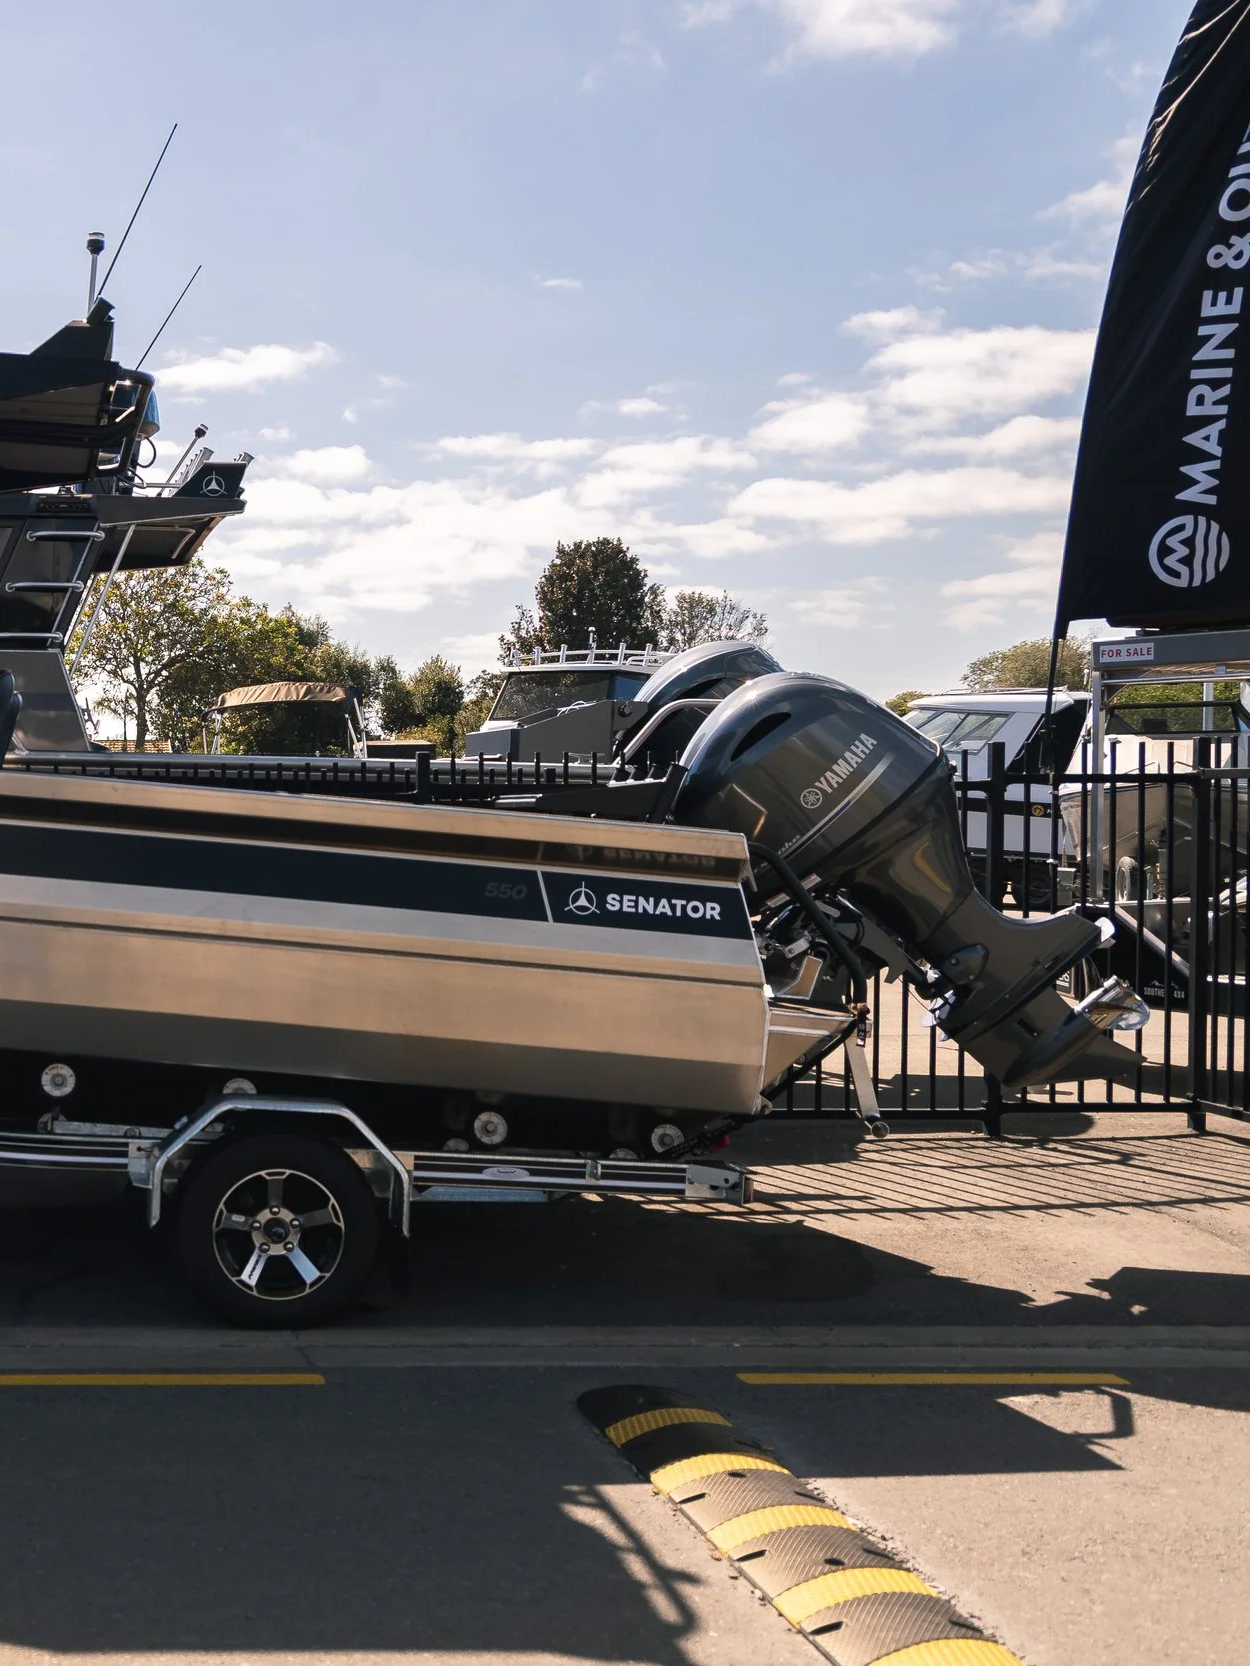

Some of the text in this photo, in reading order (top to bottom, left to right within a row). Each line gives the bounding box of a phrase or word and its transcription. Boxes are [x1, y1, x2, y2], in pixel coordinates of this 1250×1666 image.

[1207, 232, 1250, 270] &
[1175, 287, 1244, 505] MARINE
[1101, 647, 1152, 658] FOR SALE
[814, 733, 878, 794] YAMAHA
[484, 882, 527, 900] 550
[606, 893, 721, 920] SENATOR
